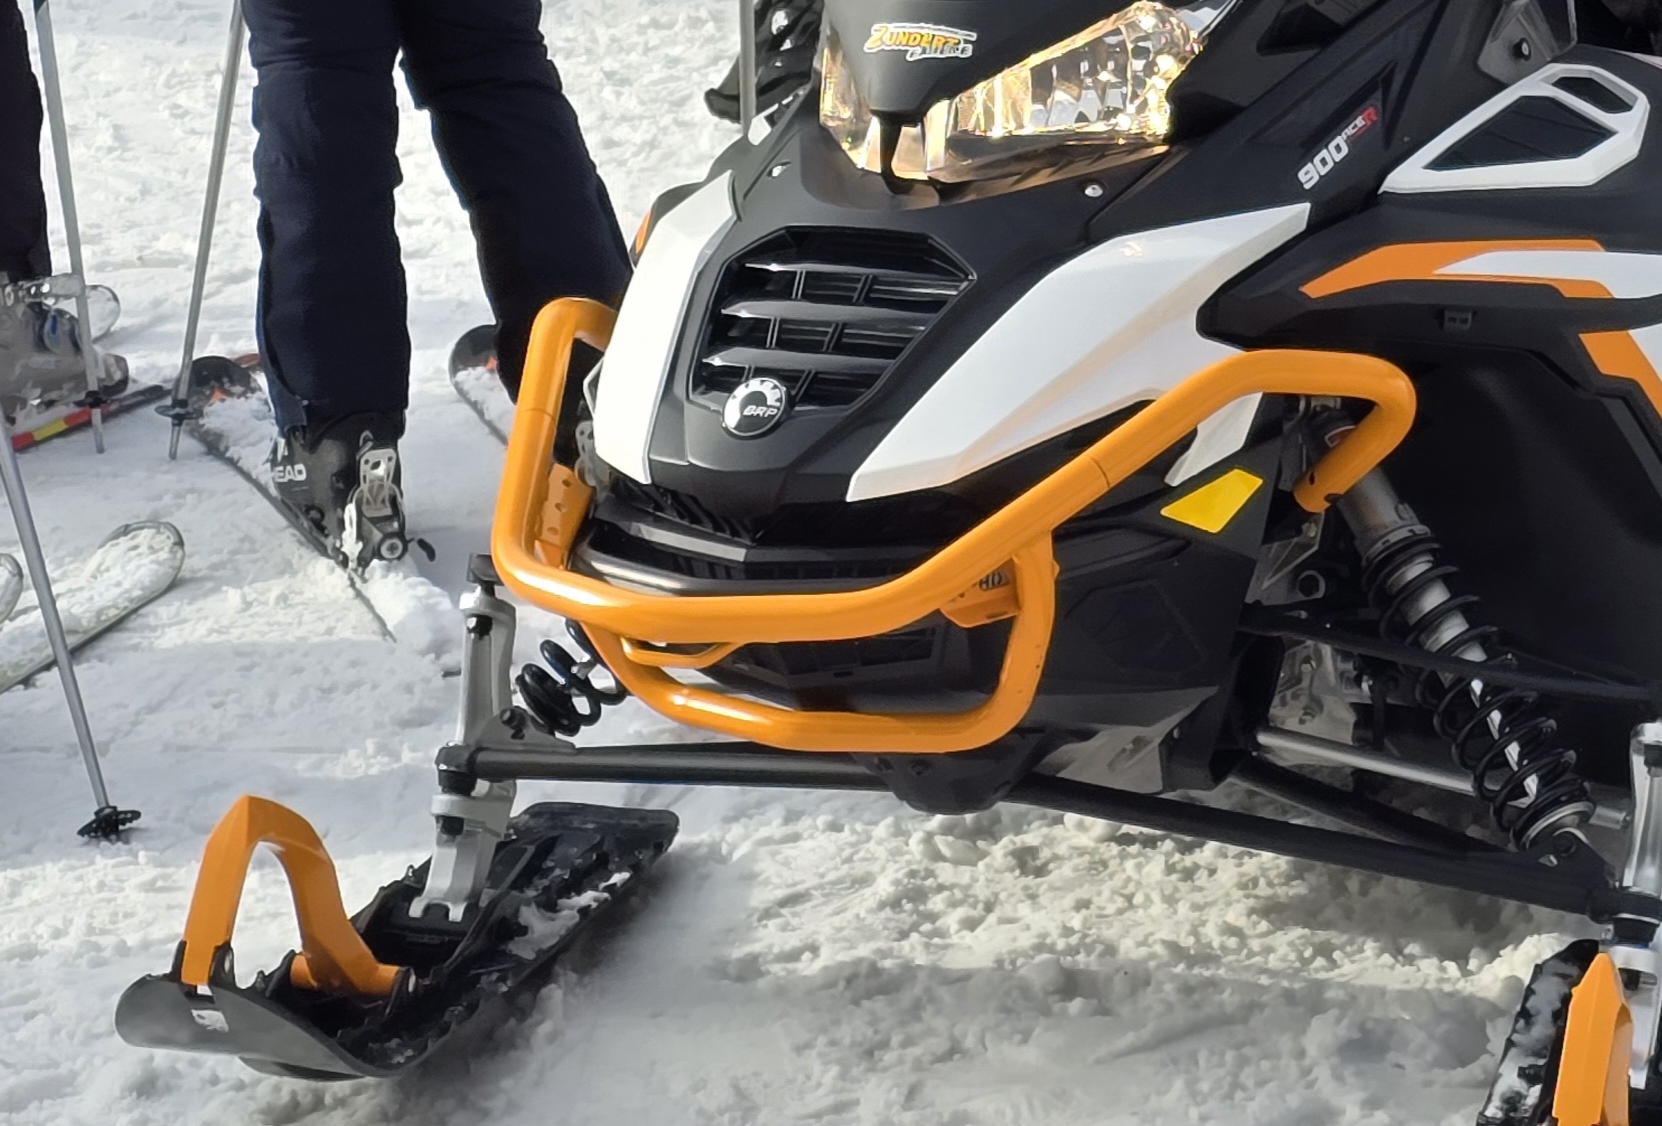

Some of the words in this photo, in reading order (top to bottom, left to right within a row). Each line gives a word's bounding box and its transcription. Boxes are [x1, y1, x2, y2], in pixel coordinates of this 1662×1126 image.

[1297, 135, 1349, 190] 900
[742, 405, 778, 417] BRP
[270, 463, 307, 483] EAD
